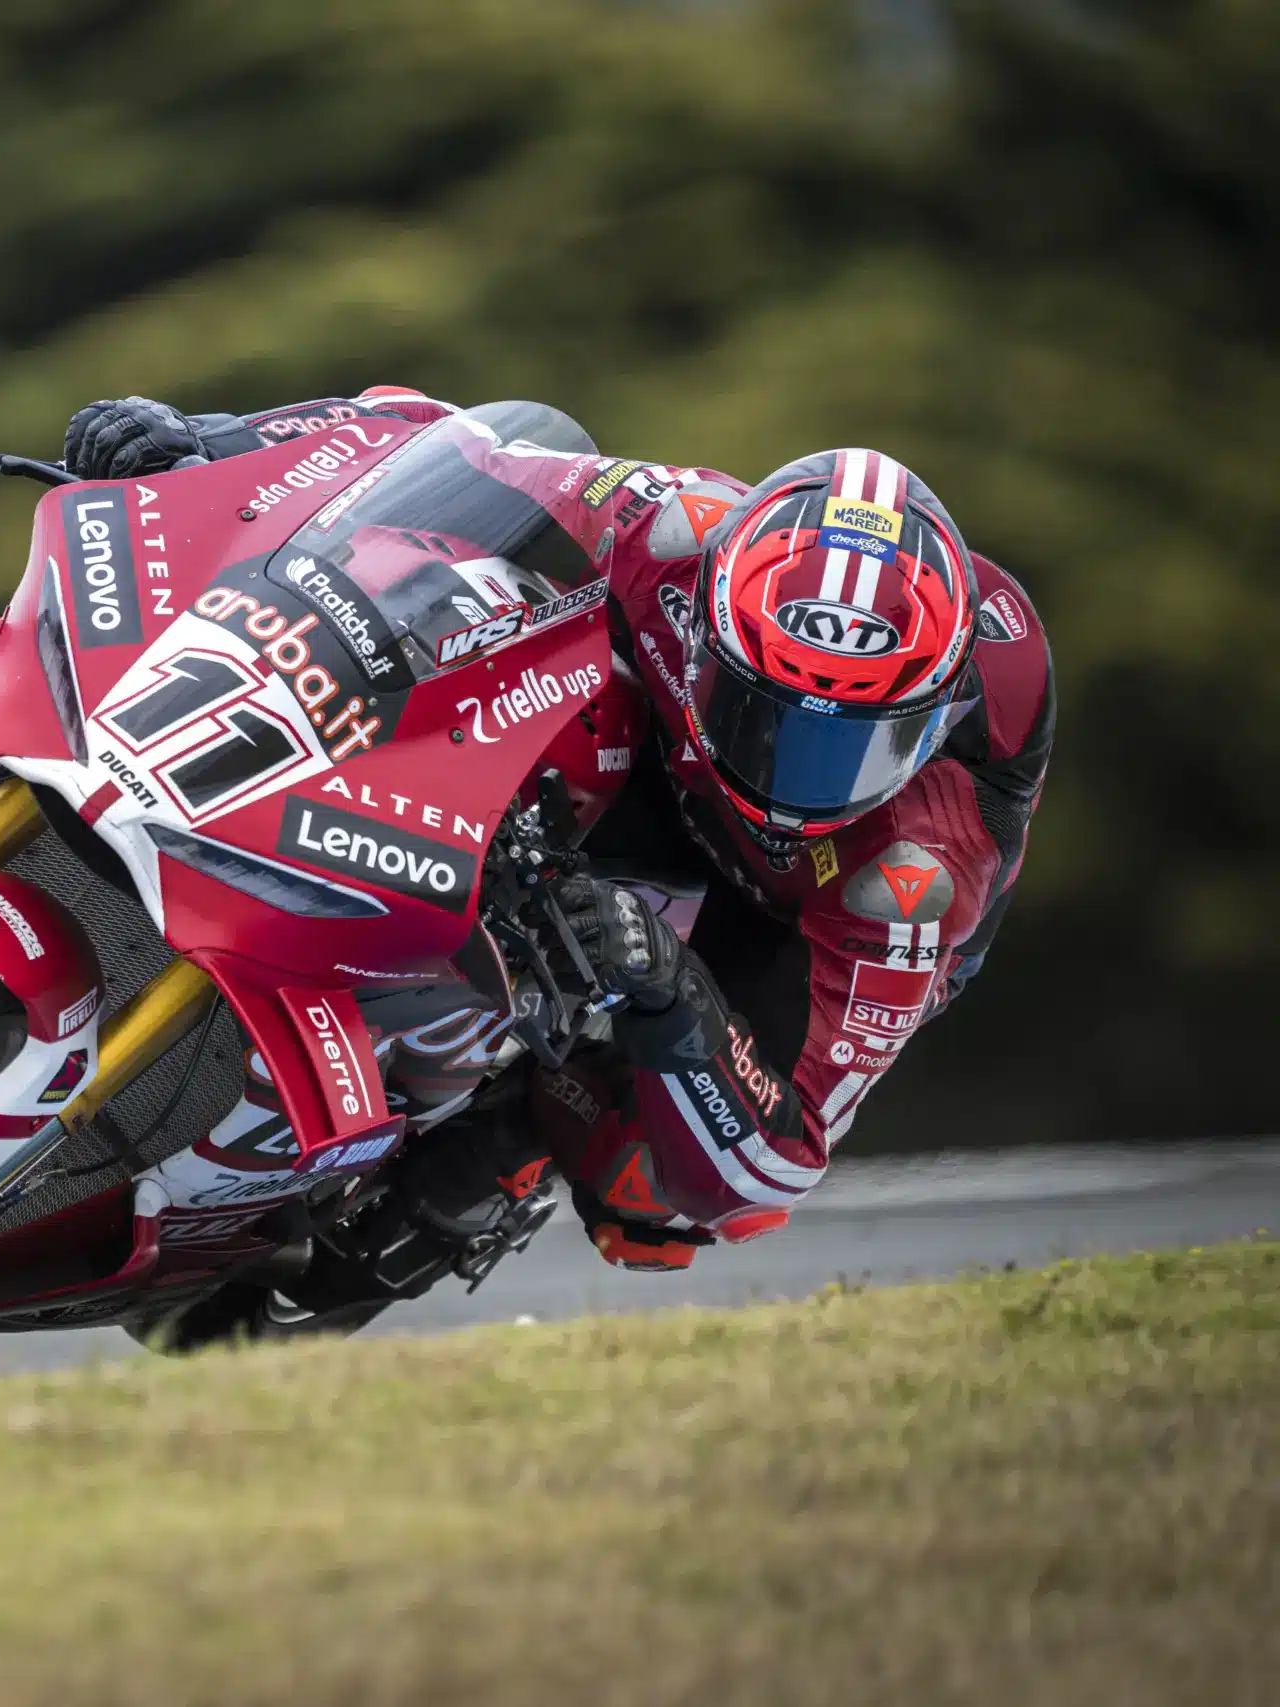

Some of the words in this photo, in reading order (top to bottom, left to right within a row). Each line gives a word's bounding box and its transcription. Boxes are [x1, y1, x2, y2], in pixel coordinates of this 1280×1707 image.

[283, 438, 360, 489] riello
[249, 484, 293, 513] ups
[834, 510, 892, 533] MARELLI
[76, 500, 121, 631] Lenovo
[135, 484, 174, 616] ALTEN
[829, 533, 888, 553] checkstar
[303, 572, 395, 676] Pratiche.it
[533, 579, 608, 625] BULEGAS
[787, 604, 891, 650] KYT
[979, 609, 998, 639] CORSE
[996, 593, 1023, 637] DUCATI
[439, 607, 523, 664] WRS
[195, 586, 383, 762] aruba.it
[716, 645, 757, 682] PASCUCCI
[494, 667, 563, 729] riello
[561, 662, 601, 702] ups
[888, 698, 937, 716] PASCUCCI
[93, 648, 312, 825] 11
[597, 748, 630, 772] DUCATI
[97, 749, 158, 810] DUCATI
[322, 775, 485, 844] ALTEN
[297, 811, 457, 893] Lenovo
[58, 985, 98, 1038] PIRELLI
[853, 1004, 919, 1030] STULZ
